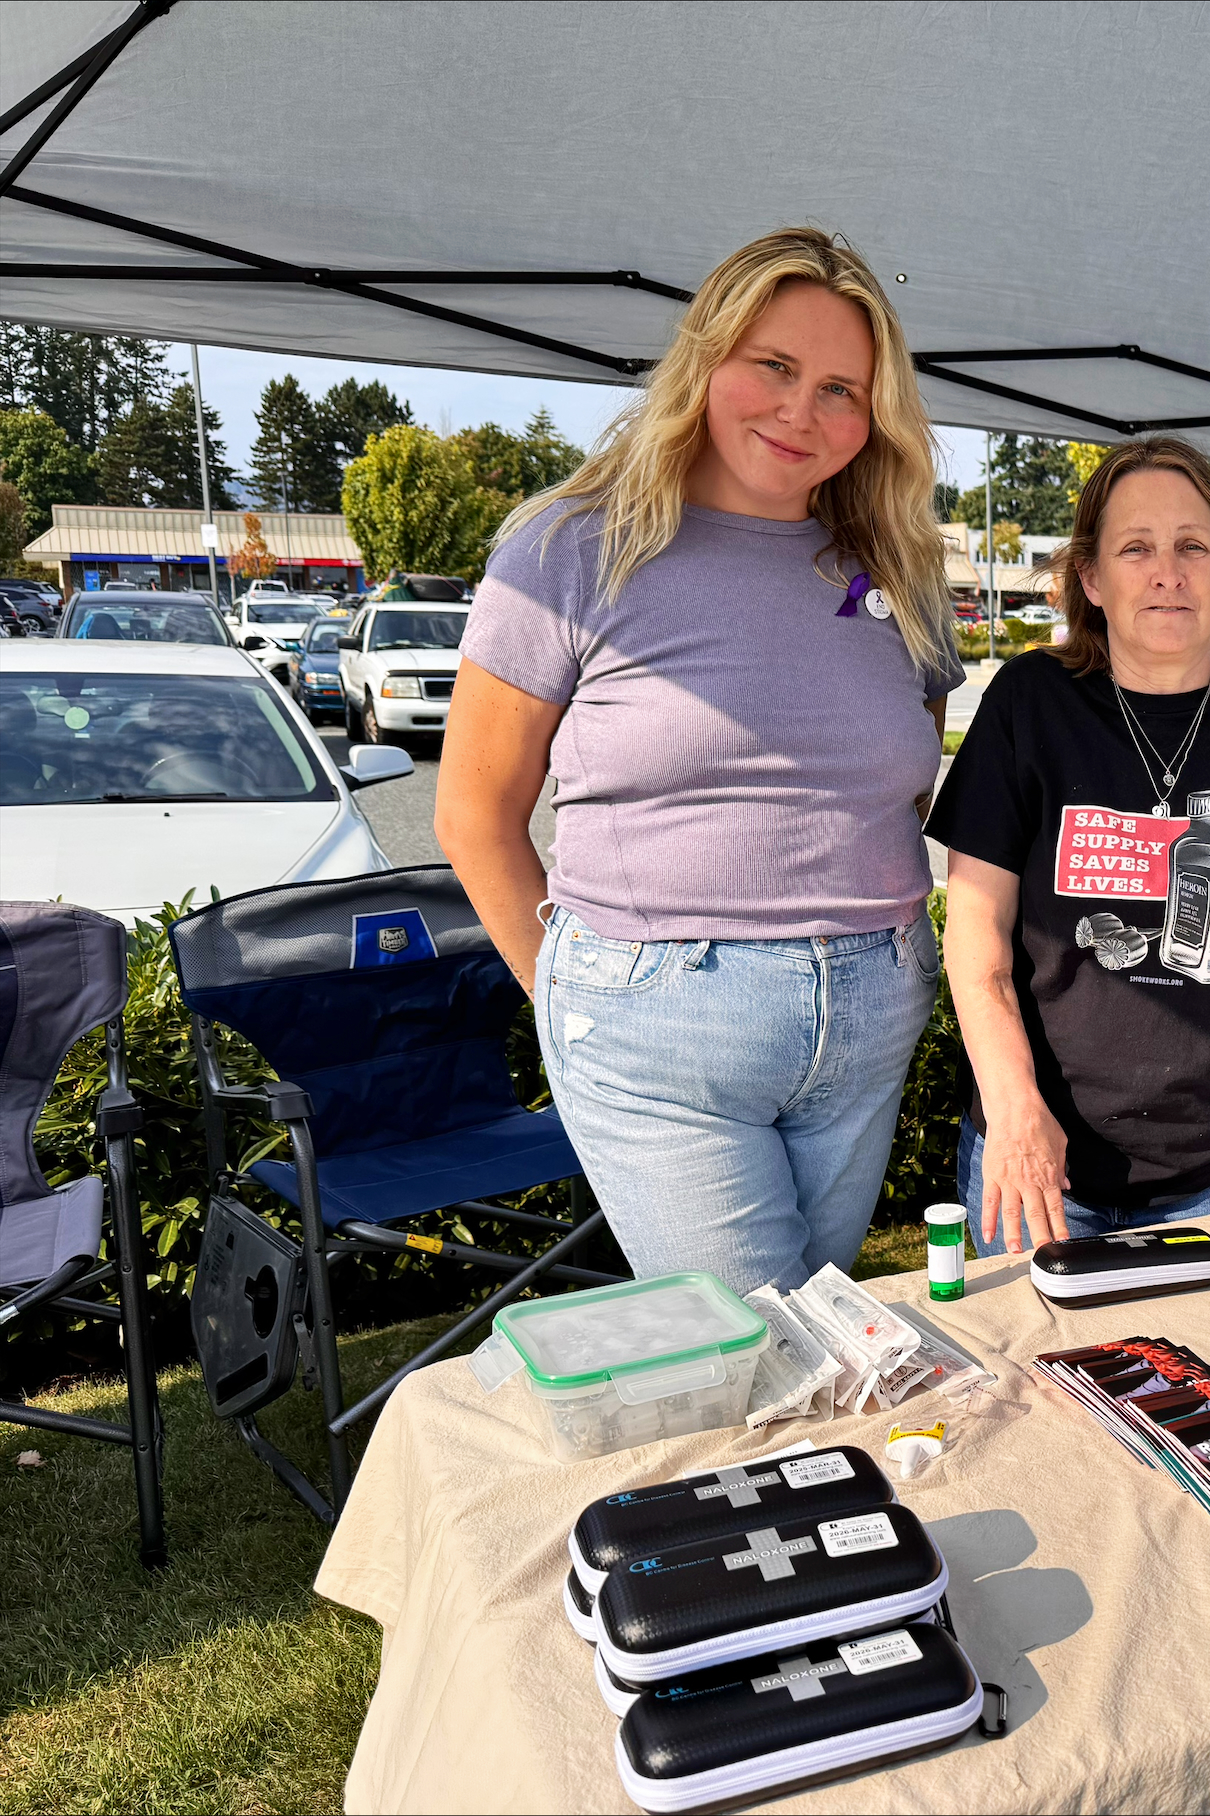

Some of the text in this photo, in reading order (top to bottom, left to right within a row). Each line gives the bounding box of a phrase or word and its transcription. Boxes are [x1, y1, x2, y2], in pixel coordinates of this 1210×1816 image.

[1074, 812, 1137, 834] SAFE
[1072, 833, 1165, 855] SUPPLY
[1069, 854, 1150, 872] SAVES
[1067, 875, 1151, 893] LIVES.
[1179, 879, 1207, 896] HEROIN
[789, 1460, 841, 1474] 2025-MAR-31
[703, 1475, 773, 1496] NALOXONE
[829, 1523, 883, 1538] 2026-MAY-31
[732, 1542, 808, 1565] NALOXONE
[850, 1640, 905, 1657] 2026-MAY-31
[761, 1663, 838, 1688] NALOXONE
